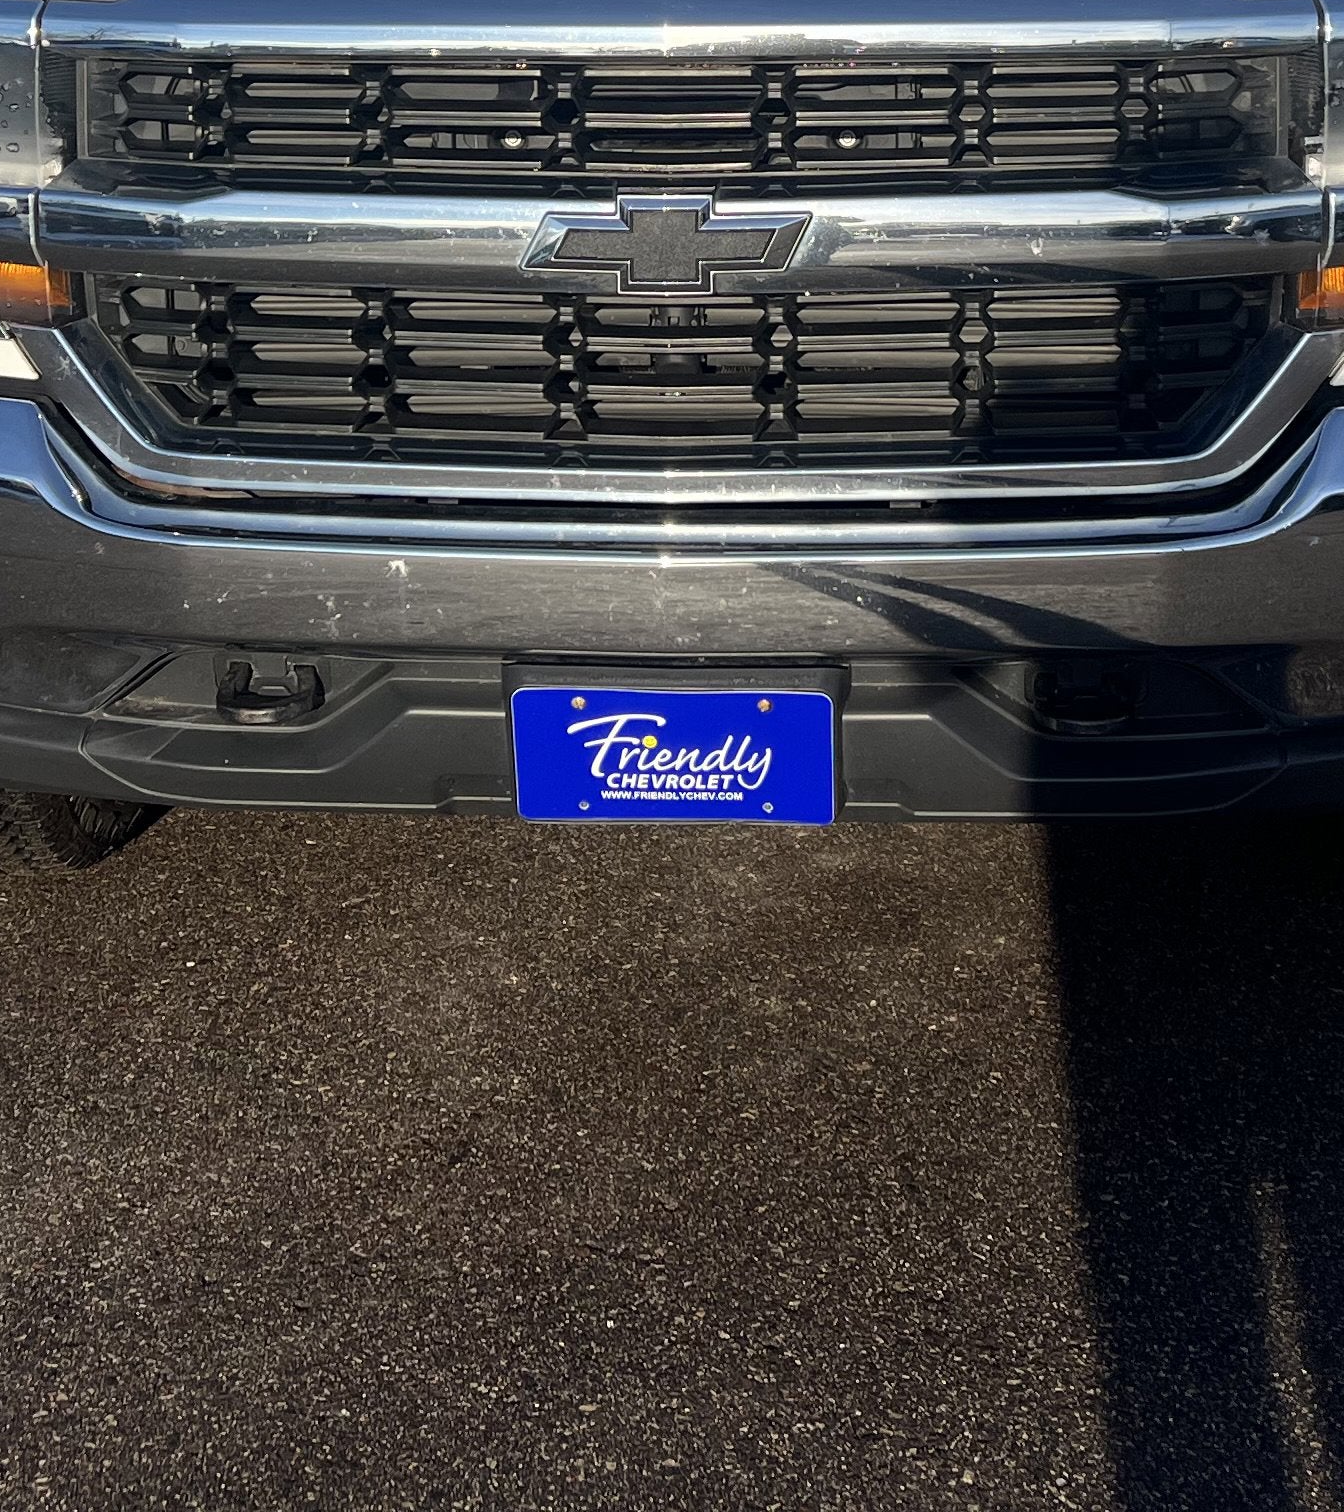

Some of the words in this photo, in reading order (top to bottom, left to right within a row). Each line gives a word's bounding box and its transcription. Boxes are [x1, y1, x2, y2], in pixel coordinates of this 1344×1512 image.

[566, 713, 772, 790] Friendly
[606, 773, 734, 790] CHEVROLET
[600, 790, 744, 801] WWW.FRIENDLYCHEV.COM
